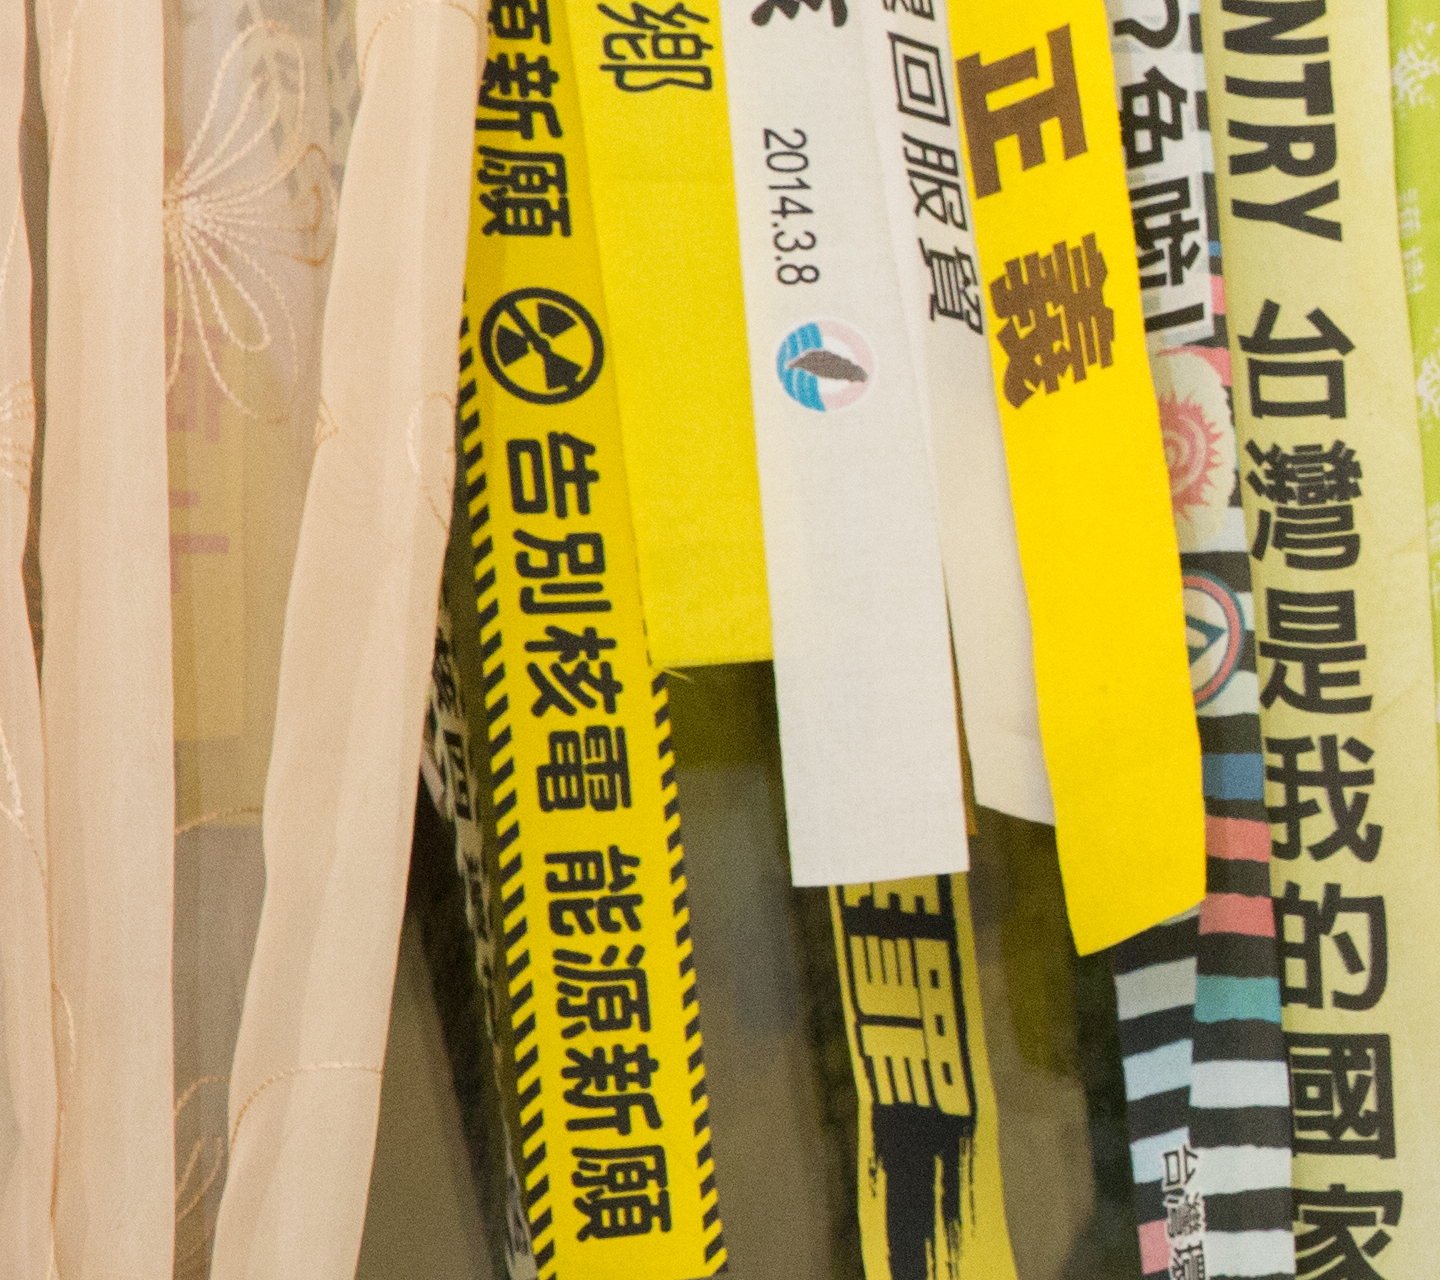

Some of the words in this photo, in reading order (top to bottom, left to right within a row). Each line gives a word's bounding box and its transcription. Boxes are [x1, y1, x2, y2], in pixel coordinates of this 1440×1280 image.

[761, 127, 821, 288] 2014.3.8
[505, 430, 636, 818] 告別核電
[543, 842, 676, 1244] 能源新願
